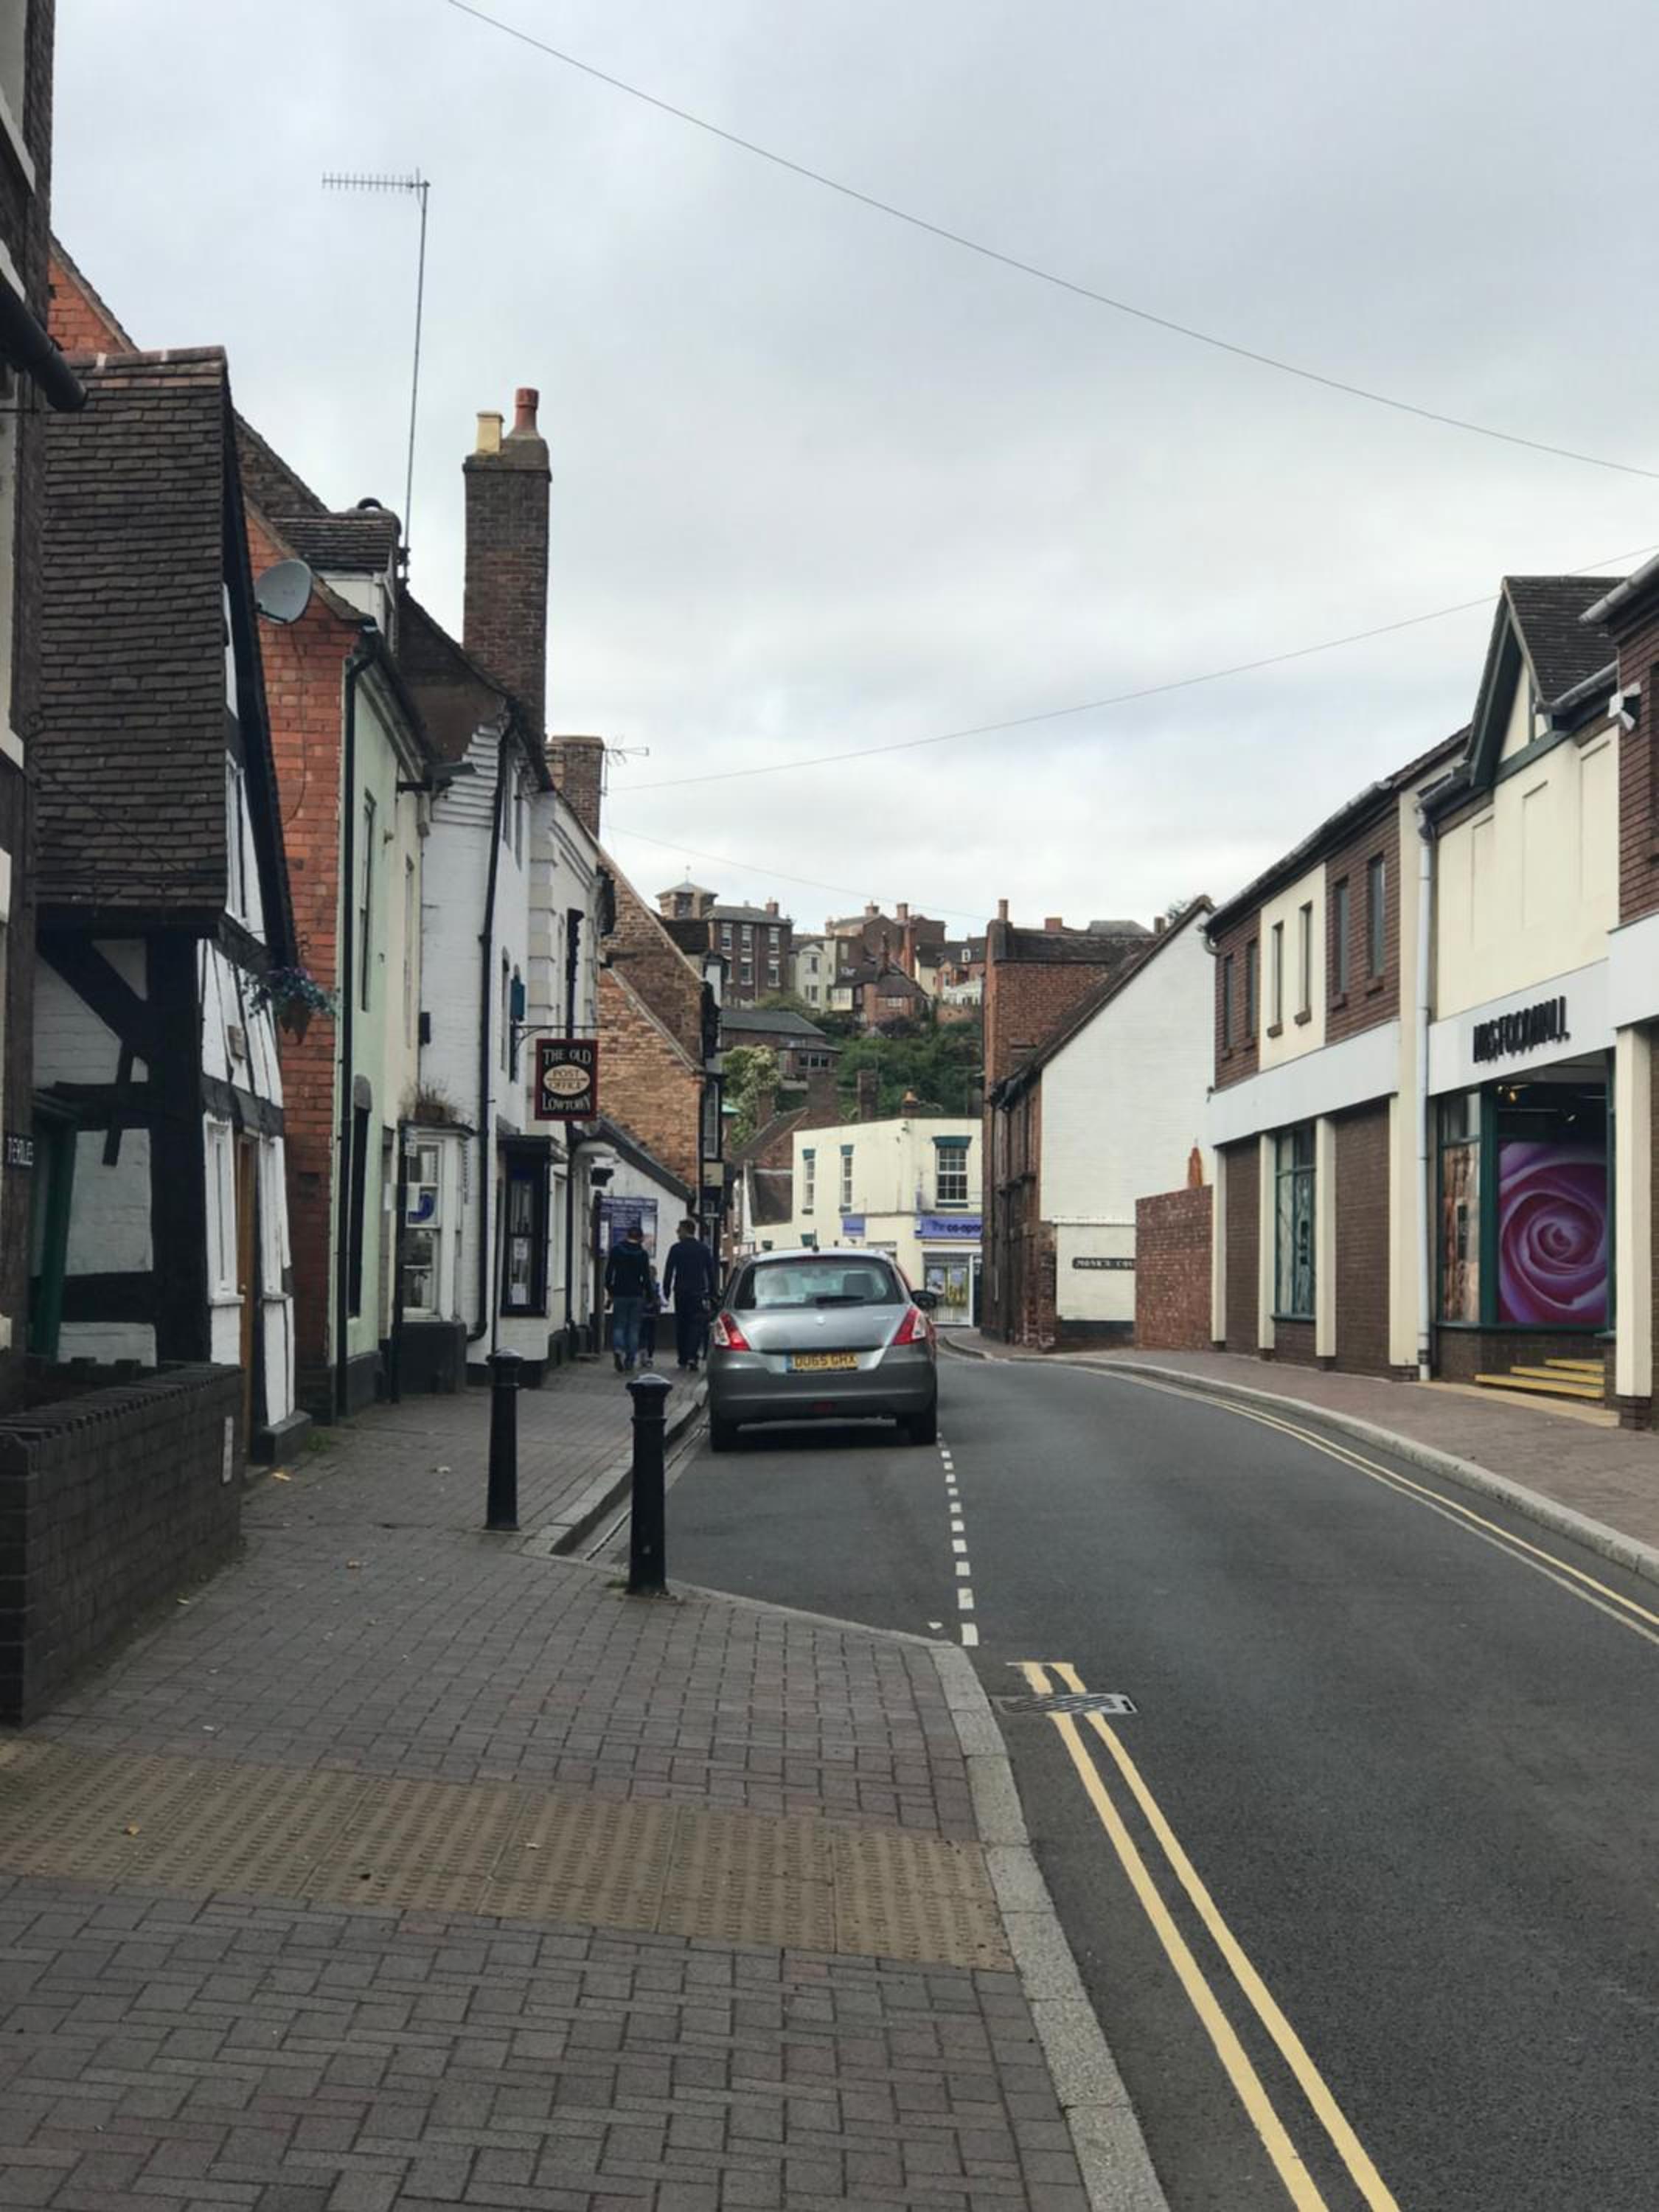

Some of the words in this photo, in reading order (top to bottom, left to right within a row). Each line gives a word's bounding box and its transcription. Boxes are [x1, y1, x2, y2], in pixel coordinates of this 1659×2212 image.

[543, 1048, 566, 1065] THE
[568, 1048, 592, 1065] OLD
[552, 1069, 580, 1078] POST
[548, 1081, 580, 1091] OFFICE
